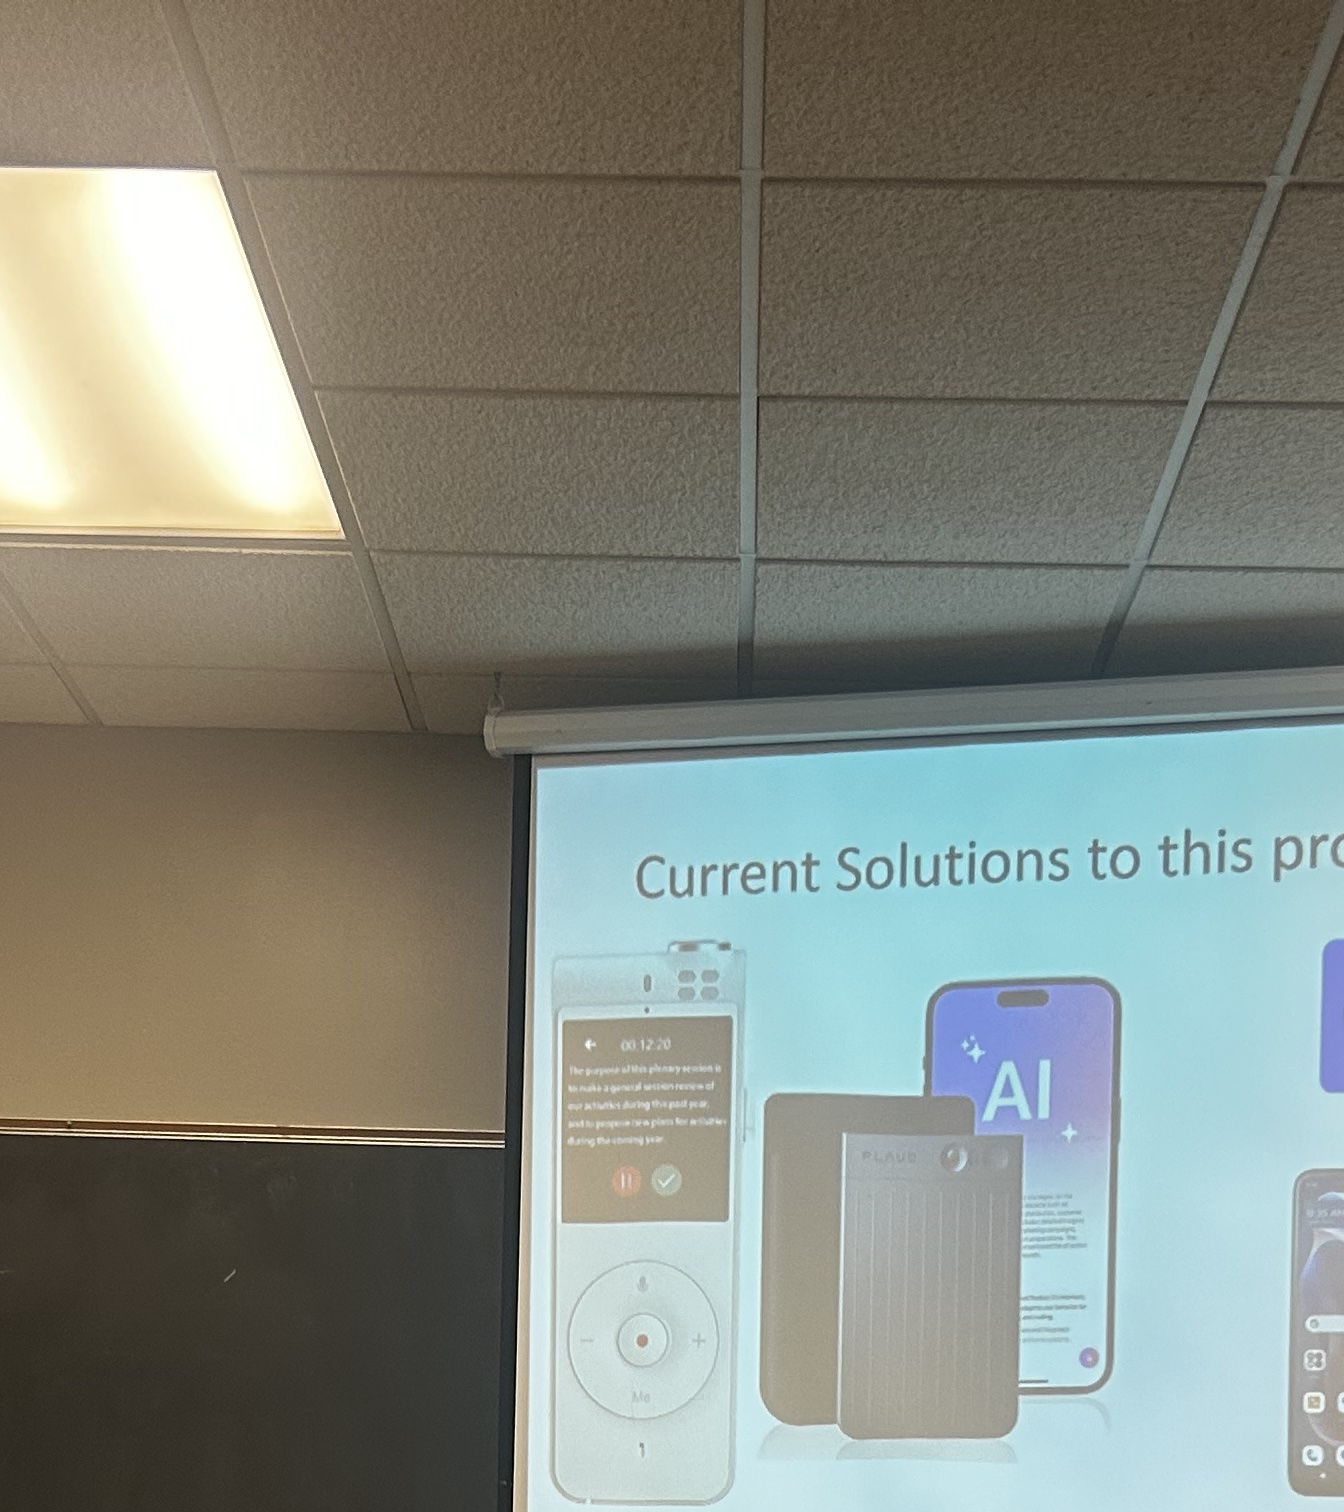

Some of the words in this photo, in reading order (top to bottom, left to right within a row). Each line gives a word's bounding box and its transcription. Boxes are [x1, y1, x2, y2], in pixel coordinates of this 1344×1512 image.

[635, 852, 821, 899] Current
[835, 840, 1071, 892] Solutions
[1087, 838, 1141, 880] to
[1158, 828, 1253, 877] this
[982, 1059, 1051, 1121] AI
